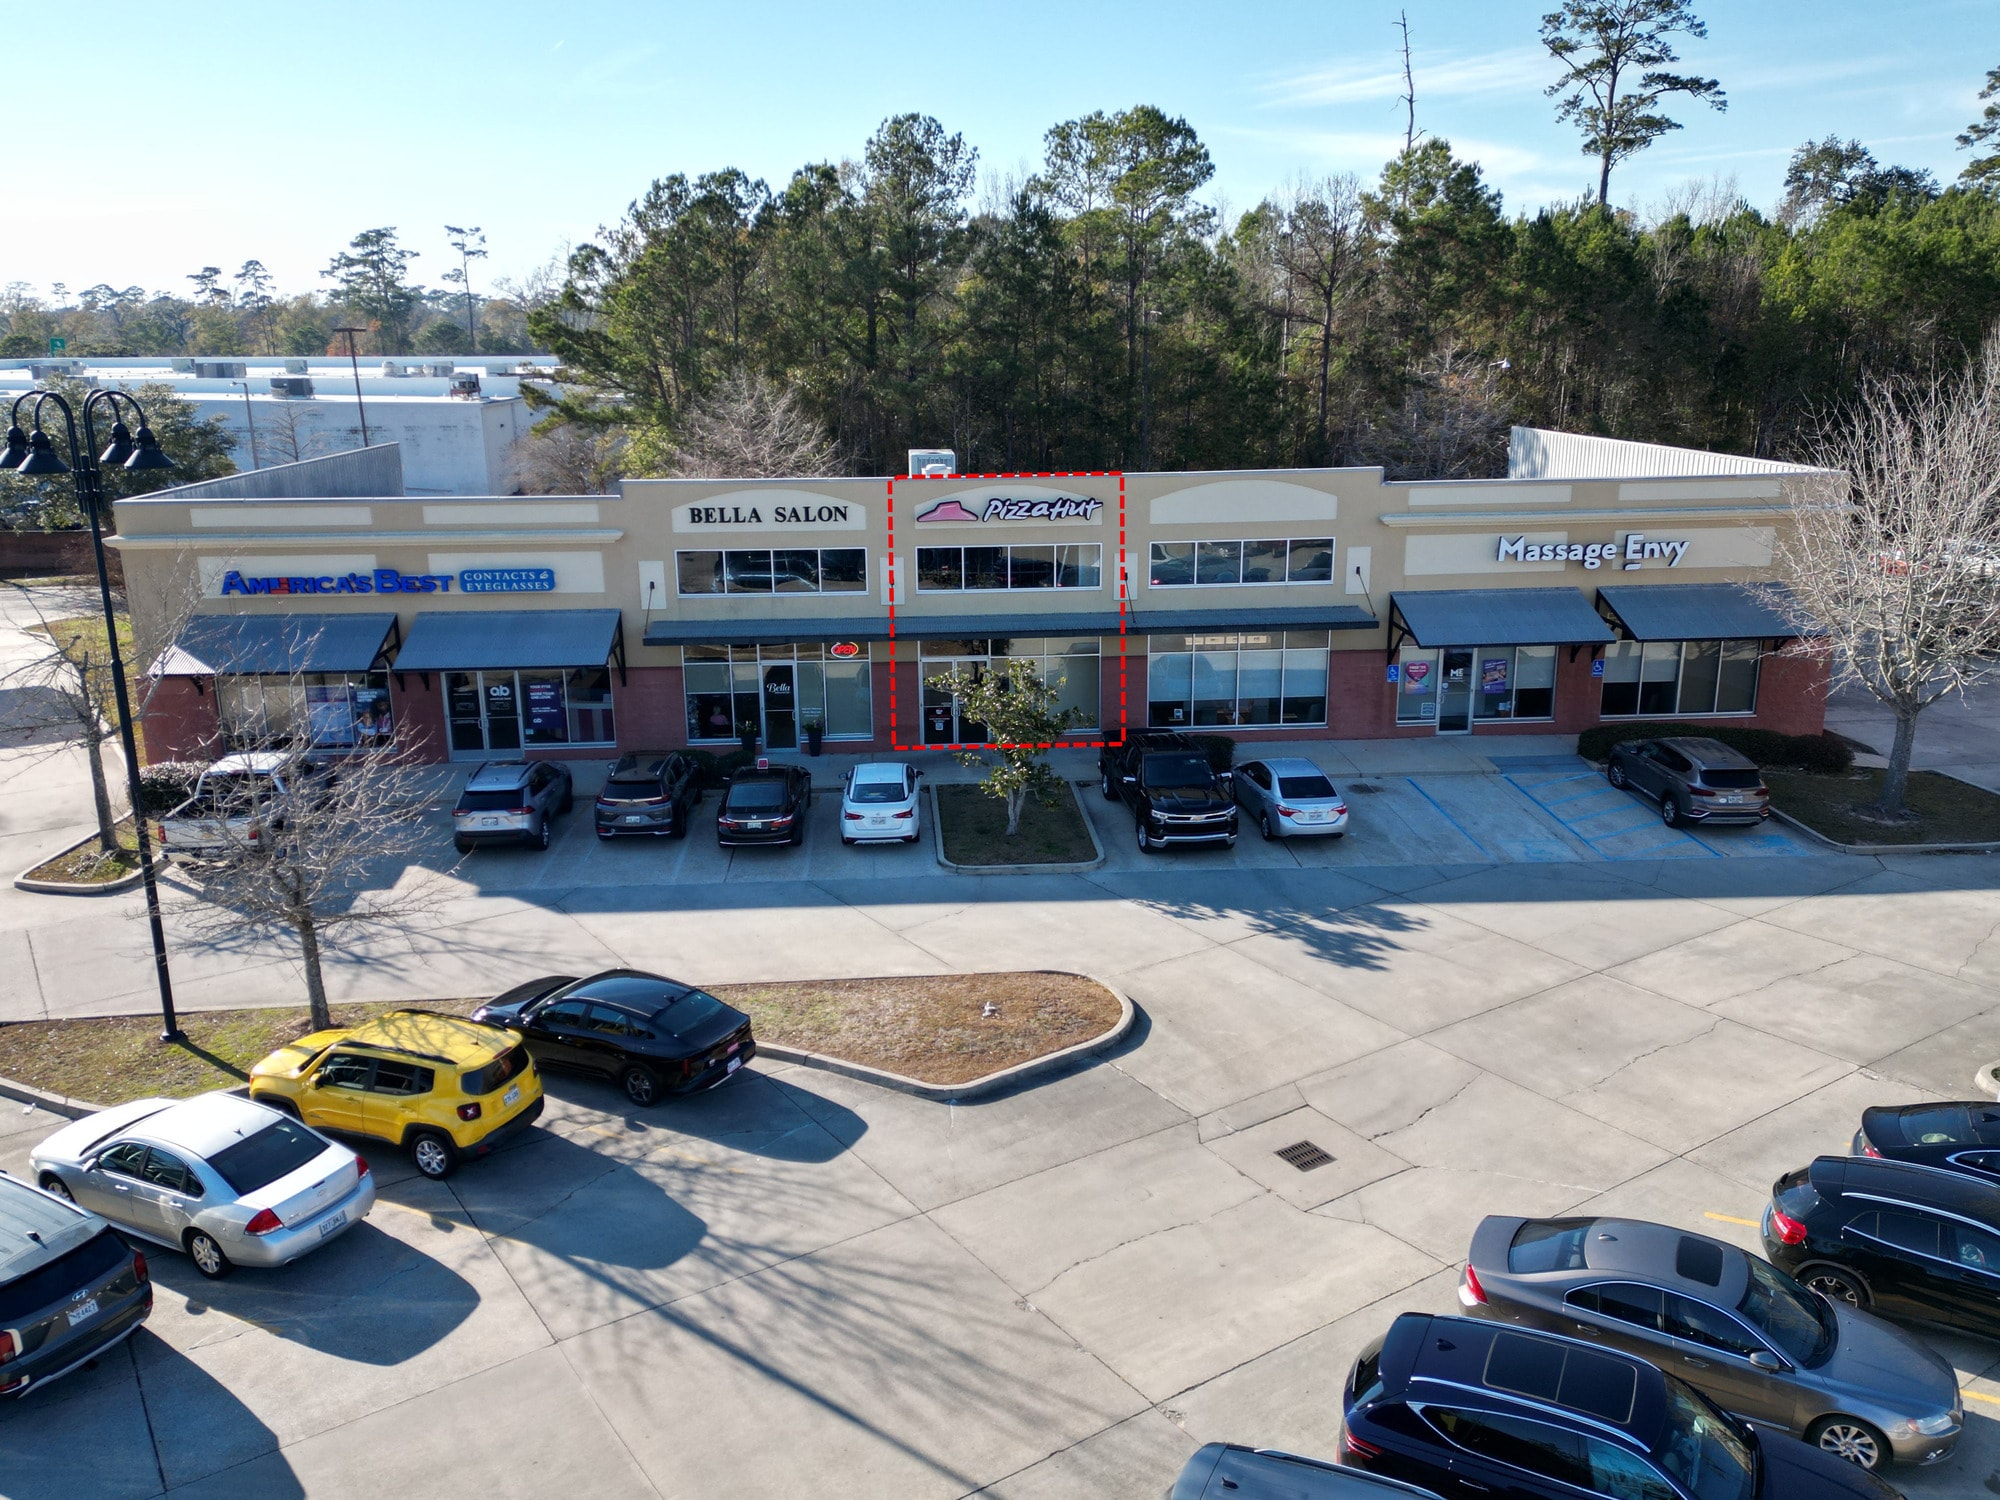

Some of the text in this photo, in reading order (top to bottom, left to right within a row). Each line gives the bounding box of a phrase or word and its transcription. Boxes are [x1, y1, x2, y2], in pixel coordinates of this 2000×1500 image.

[688, 506, 848, 524] BELLA SALON
[1496, 534, 1690, 570] Massage Envy
[372, 568, 454, 593] BEST
[463, 571, 536, 581] CONTACTS
[466, 581, 550, 592] EYEGLASSES
[832, 644, 857, 655] OPEN
[766, 682, 791, 693] Bella
